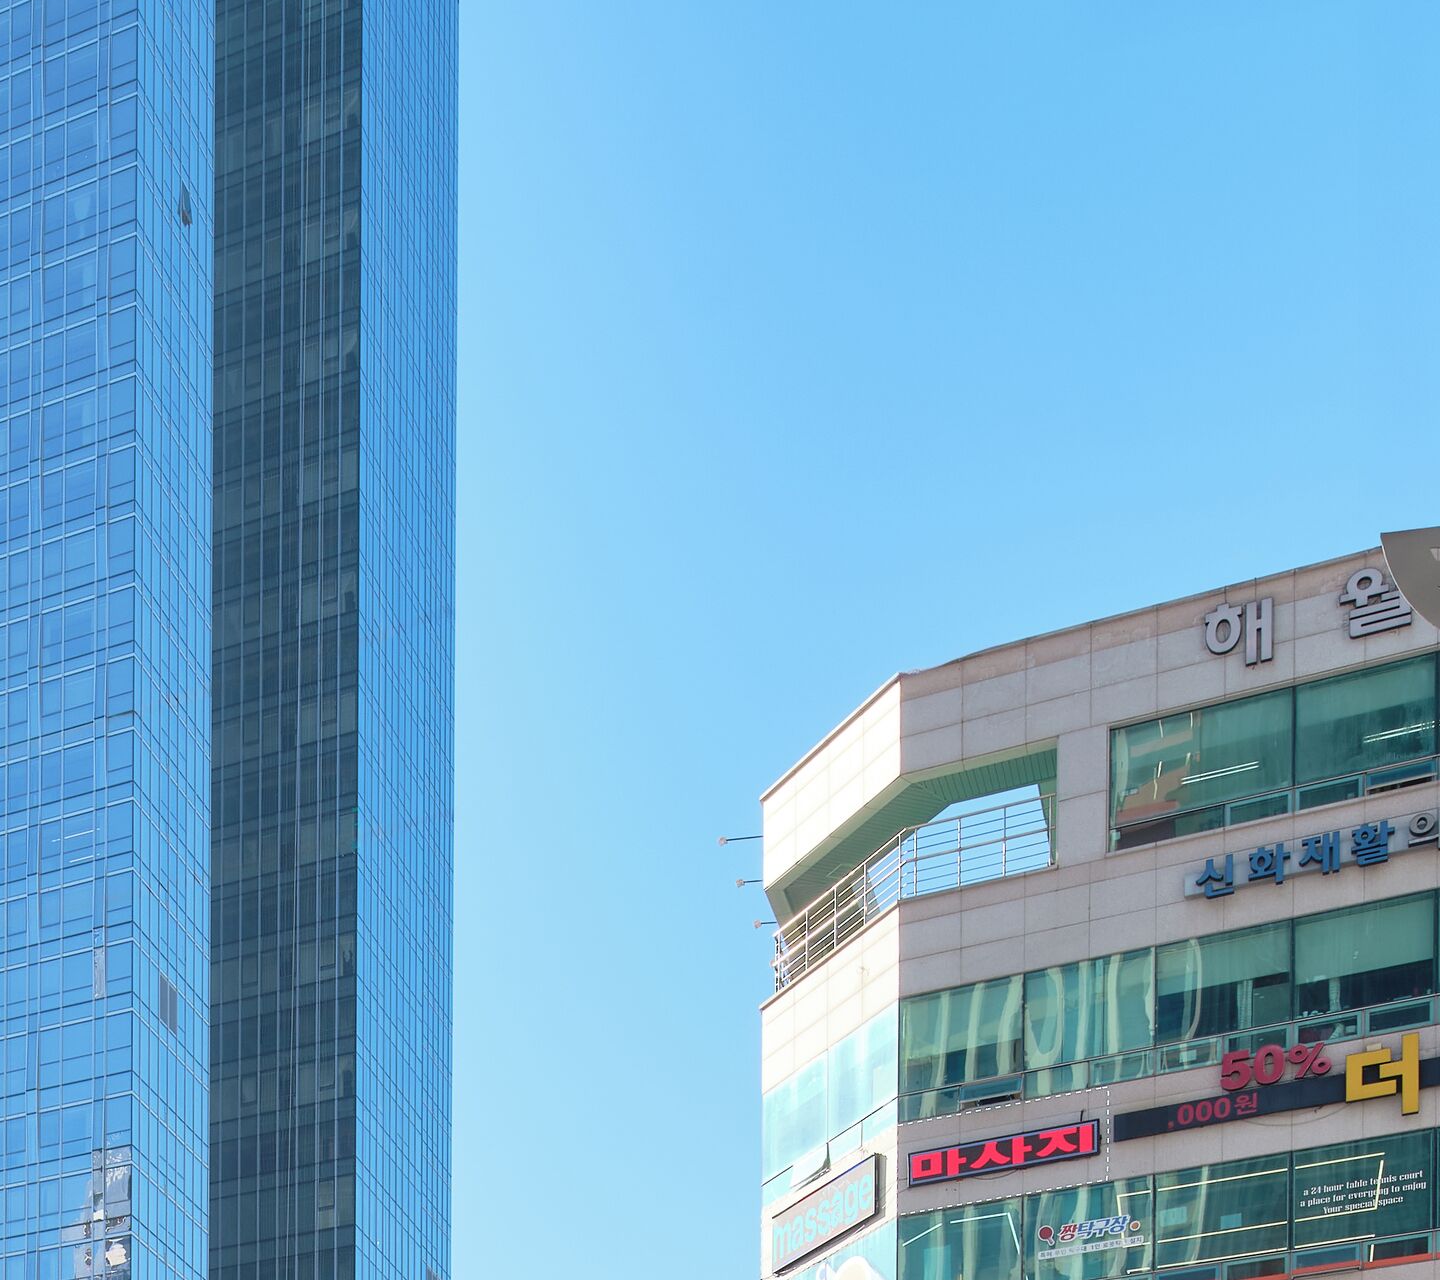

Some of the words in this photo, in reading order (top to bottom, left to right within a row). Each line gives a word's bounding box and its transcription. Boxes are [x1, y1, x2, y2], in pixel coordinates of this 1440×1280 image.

[1220, 1042, 1332, 1091] 50%
[911, 1123, 1095, 1180] 마사지
[772, 1171, 873, 1262] massage
[1378, 1195, 1404, 1206] space
[1059, 1215, 1130, 1242] 짱탁구장
